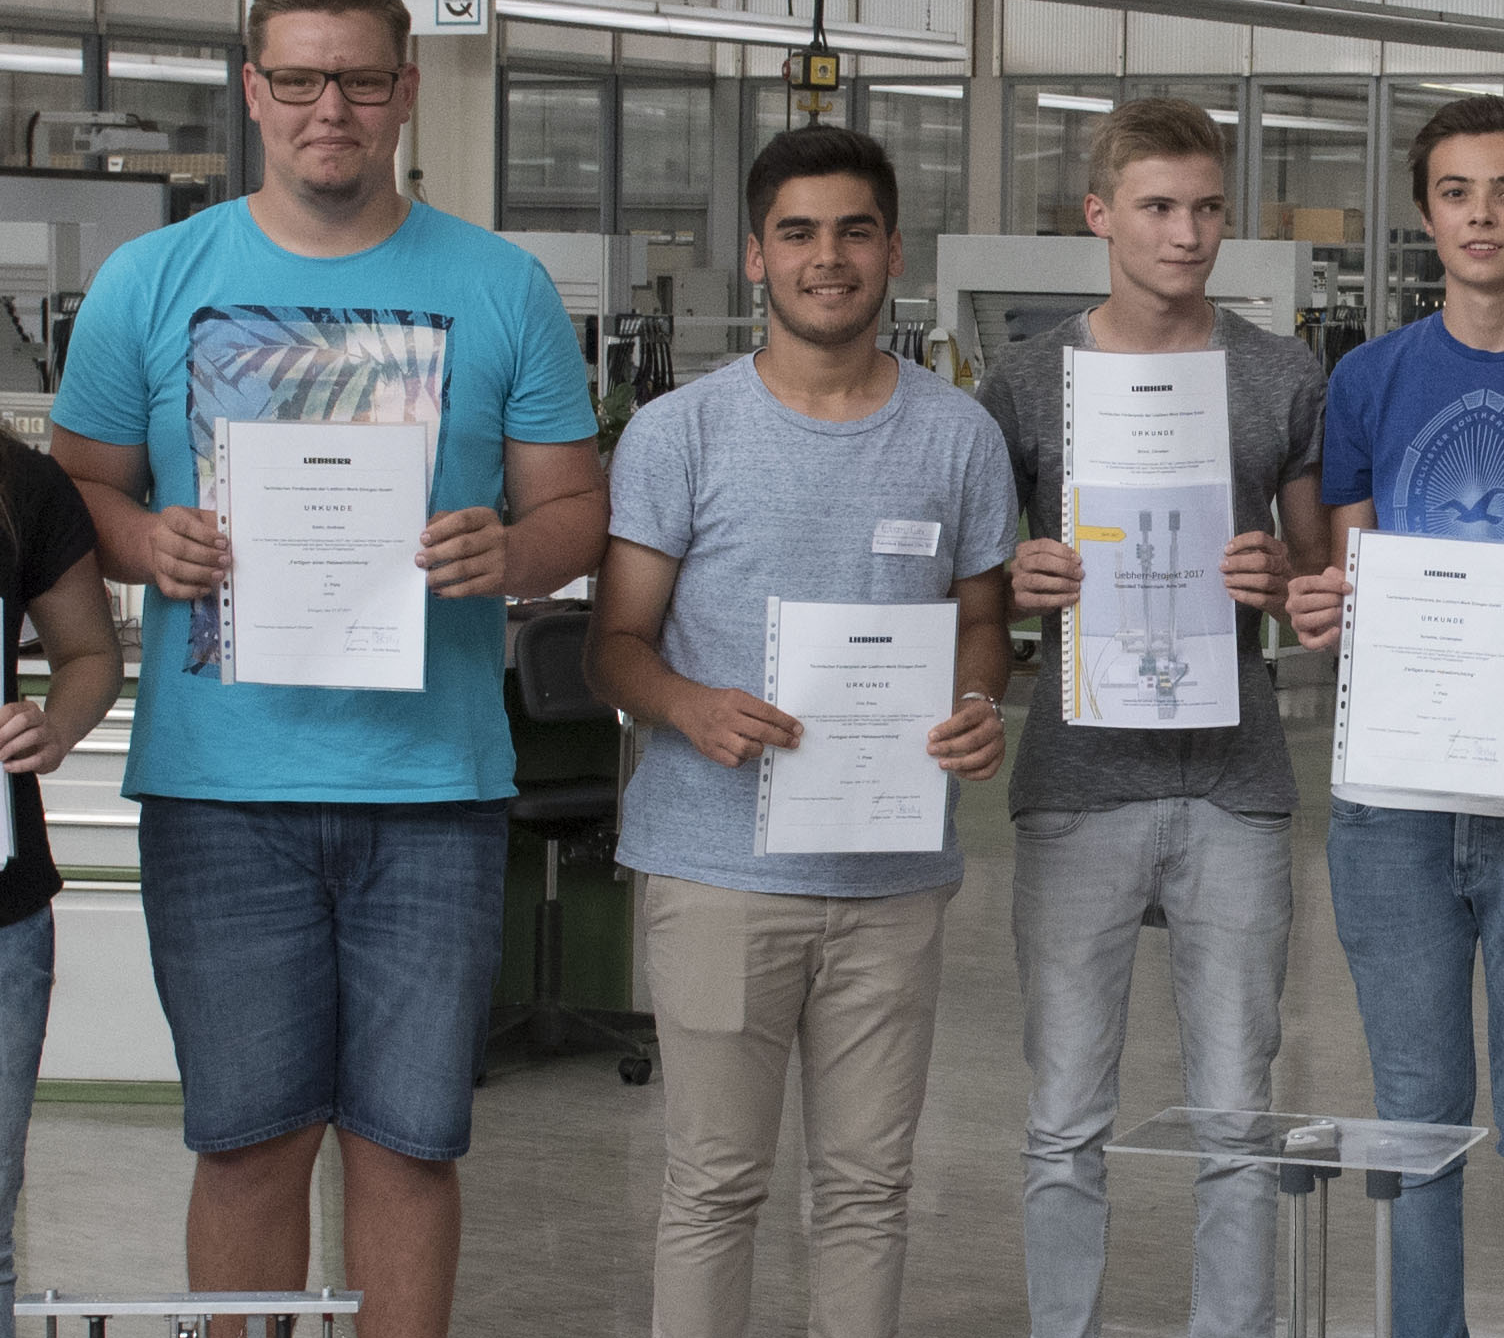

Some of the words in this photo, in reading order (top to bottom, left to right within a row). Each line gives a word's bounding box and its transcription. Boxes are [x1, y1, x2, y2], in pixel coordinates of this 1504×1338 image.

[1131, 384, 1173, 392] LIEBHERR
[1131, 429, 1175, 437] URKUNDE
[303, 457, 352, 465] LIEBHERR
[1414, 432, 1450, 496] HOLLISTER
[303, 504, 353, 512] URKUNDE
[1114, 570, 1182, 581] Liebherr-Projekt
[1183, 569, 1205, 579] 2017
[1423, 569, 1467, 580] LIEBHERR
[1421, 615, 1465, 625] URKUNDE
[848, 636, 893, 644] LIEBHERR
[846, 681, 891, 689] URKUNDE
